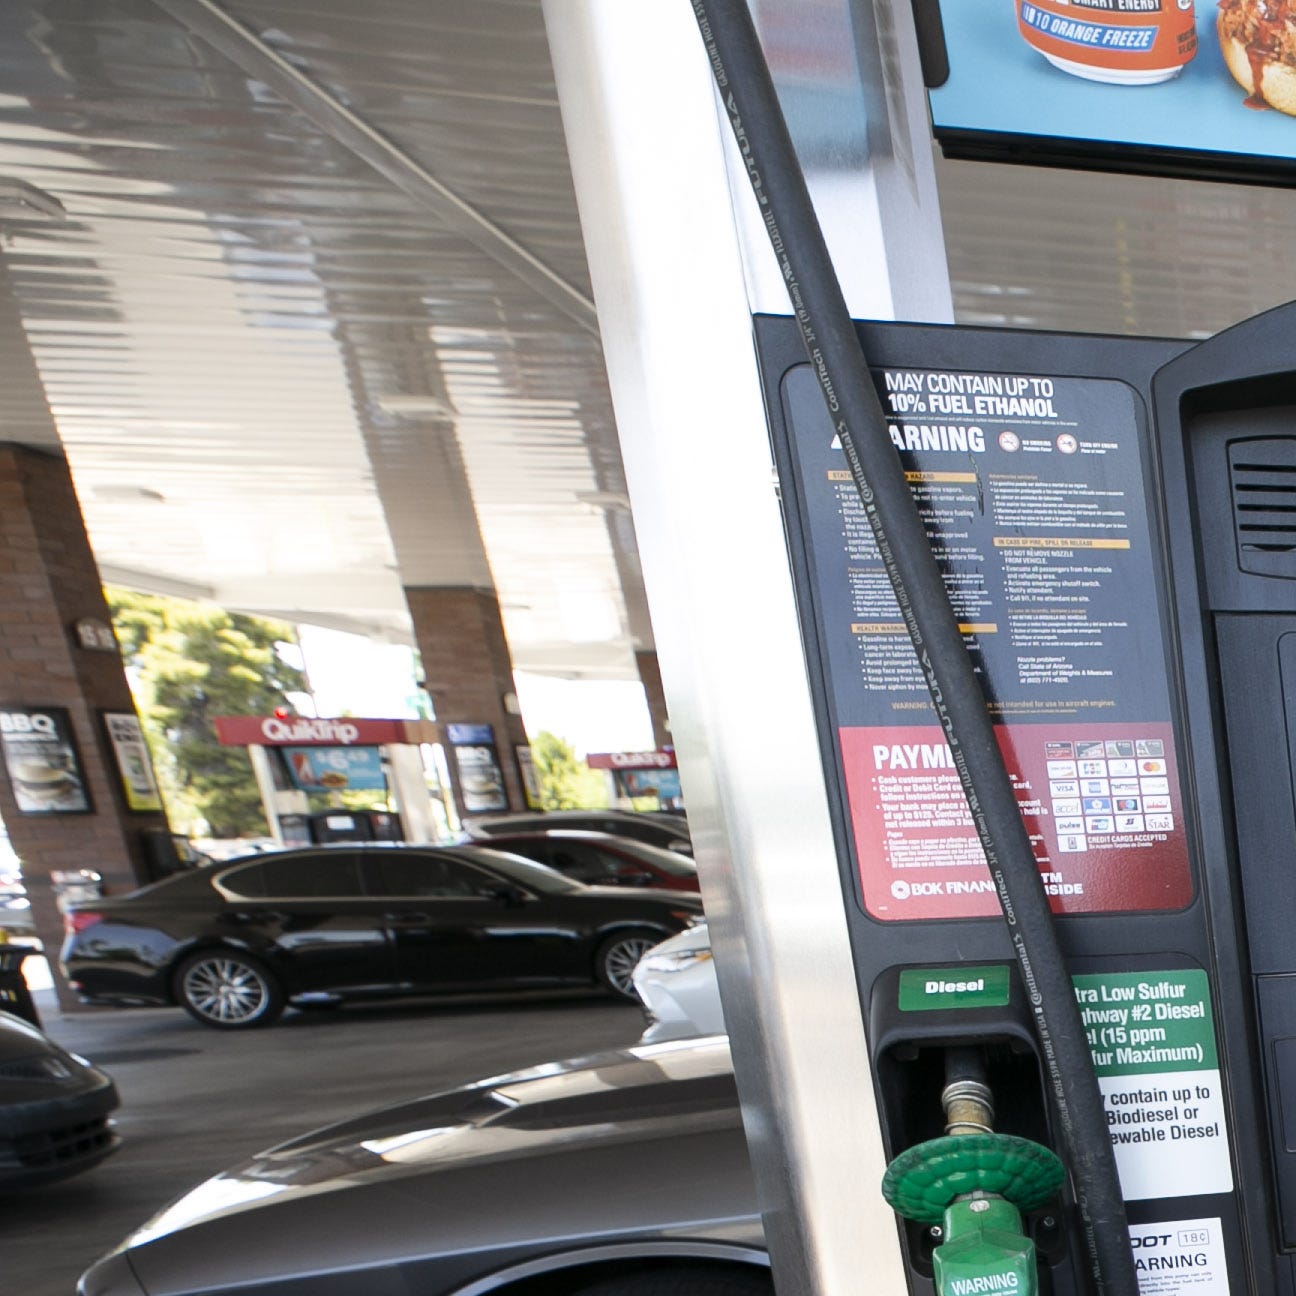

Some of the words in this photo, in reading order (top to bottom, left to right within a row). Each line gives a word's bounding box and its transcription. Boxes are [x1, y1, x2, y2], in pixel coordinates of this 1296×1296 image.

[1051, 20, 1102, 44] ORANGE
[1102, 30, 1152, 47] FREEZE
[726, 91, 768, 204] FUTURA
[813, 348, 839, 412] ContiTech
[885, 372, 924, 391] MAY
[927, 374, 1003, 396] CONTAIN
[1005, 378, 1028, 396] UP
[1029, 378, 1054, 397] TO
[888, 393, 926, 413] 10%
[928, 394, 973, 415] FUEL
[974, 396, 1058, 418] ETHANOL
[889, 425, 986, 453] ARNING
[842, 432, 874, 505] Continental
[920, 650, 957, 745] FUTURA
[261, 719, 358, 745] QuikTrip
[873, 744, 956, 770] PAYM
[1134, 834, 1167, 842] ACCEPTED
[911, 883, 943, 896] BOK
[946, 881, 996, 893] FINAN
[1041, 872, 1062, 883] TM
[1044, 884, 1083, 896] SIDE
[924, 979, 984, 995] Diesel
[1075, 987, 1098, 1003] tra
[1101, 985, 1136, 1002] Low
[1139, 982, 1186, 1000] Sulfur
[1082, 1008, 1128, 1026] hway
[1131, 1004, 1153, 1019] #2
[1155, 1001, 1205, 1020] Diesel
[1100, 1030, 1127, 1047] (15
[1129, 1028, 1166, 1045] ppm
[1092, 1050, 1114, 1066] fur
[1116, 1044, 1203, 1065] Maximum)
[1110, 1089, 1168, 1105] contain
[1172, 1088, 1191, 1103] up
[1196, 1085, 1210, 1099] to
[1107, 1107, 1179, 1125] Biodiesel
[1184, 1107, 1199, 1119] or
[1110, 1123, 1166, 1145] ewable
[1171, 1122, 1220, 1140] Diesel
[1136, 1253, 1207, 1271] ARNING
[951, 1271, 1018, 1296] WARNING
